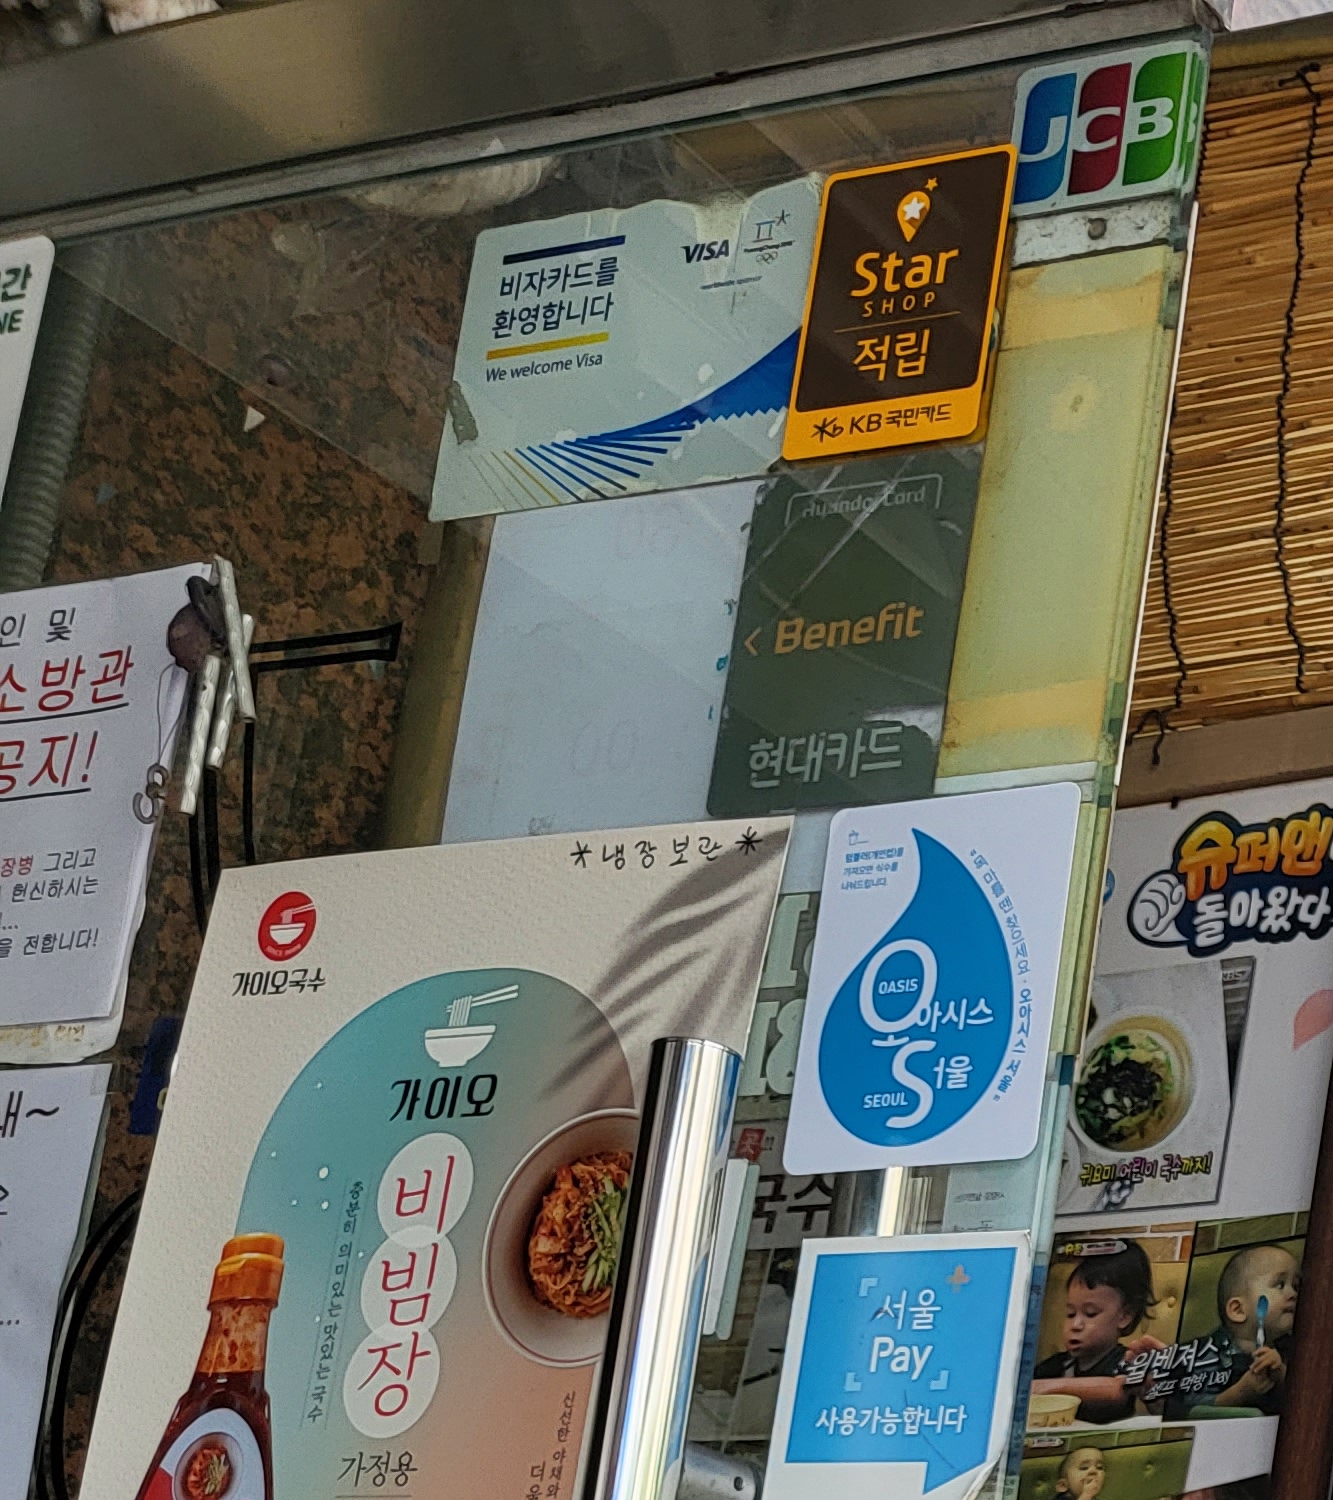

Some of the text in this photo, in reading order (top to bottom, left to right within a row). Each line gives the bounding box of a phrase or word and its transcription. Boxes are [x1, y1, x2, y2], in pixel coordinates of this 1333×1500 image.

[1018, 96, 1176, 164] JCB
[681, 239, 731, 264] VISA
[850, 249, 960, 298] Star
[499, 256, 619, 301] 비자카드를
[491, 291, 615, 340] 환영합니다
[861, 291, 937, 318] SHOP
[486, 352, 604, 384] We welcome Visa
[853, 328, 931, 382] 적립
[849, 402, 953, 437] KB 국민카드
[773, 601, 925, 655] Benefit
[0, 730, 99, 796] 공지!
[747, 725, 904, 789] 현대카드
[43, 848, 97, 872] 그리고
[11, 875, 99, 903] 헌신하시는
[1193, 886, 1332, 949] 돌아왔다
[23, 927, 99, 956] 전합니다!
[231, 966, 327, 998] 가이오국수
[877, 977, 920, 995] OASIS
[388, 1073, 499, 1122] 가이오
[862, 1090, 910, 1109] SEOUL
[1079, 1162, 1117, 1188] 귀요미
[1160, 1150, 1214, 1183] 국수까지!
[357, 1155, 456, 1417] 비빔장
[872, 1287, 943, 1334] 서울
[868, 1335, 935, 1383] Pay
[1124, 1336, 1221, 1385] 윌벤져스
[306, 1385, 328, 1424] 국수
[556, 1390, 577, 1444] 신선한
[814, 1404, 969, 1438] 사용가능합니다
[337, 1450, 419, 1488] 가정용
[546, 1447, 568, 1500] 야채와
